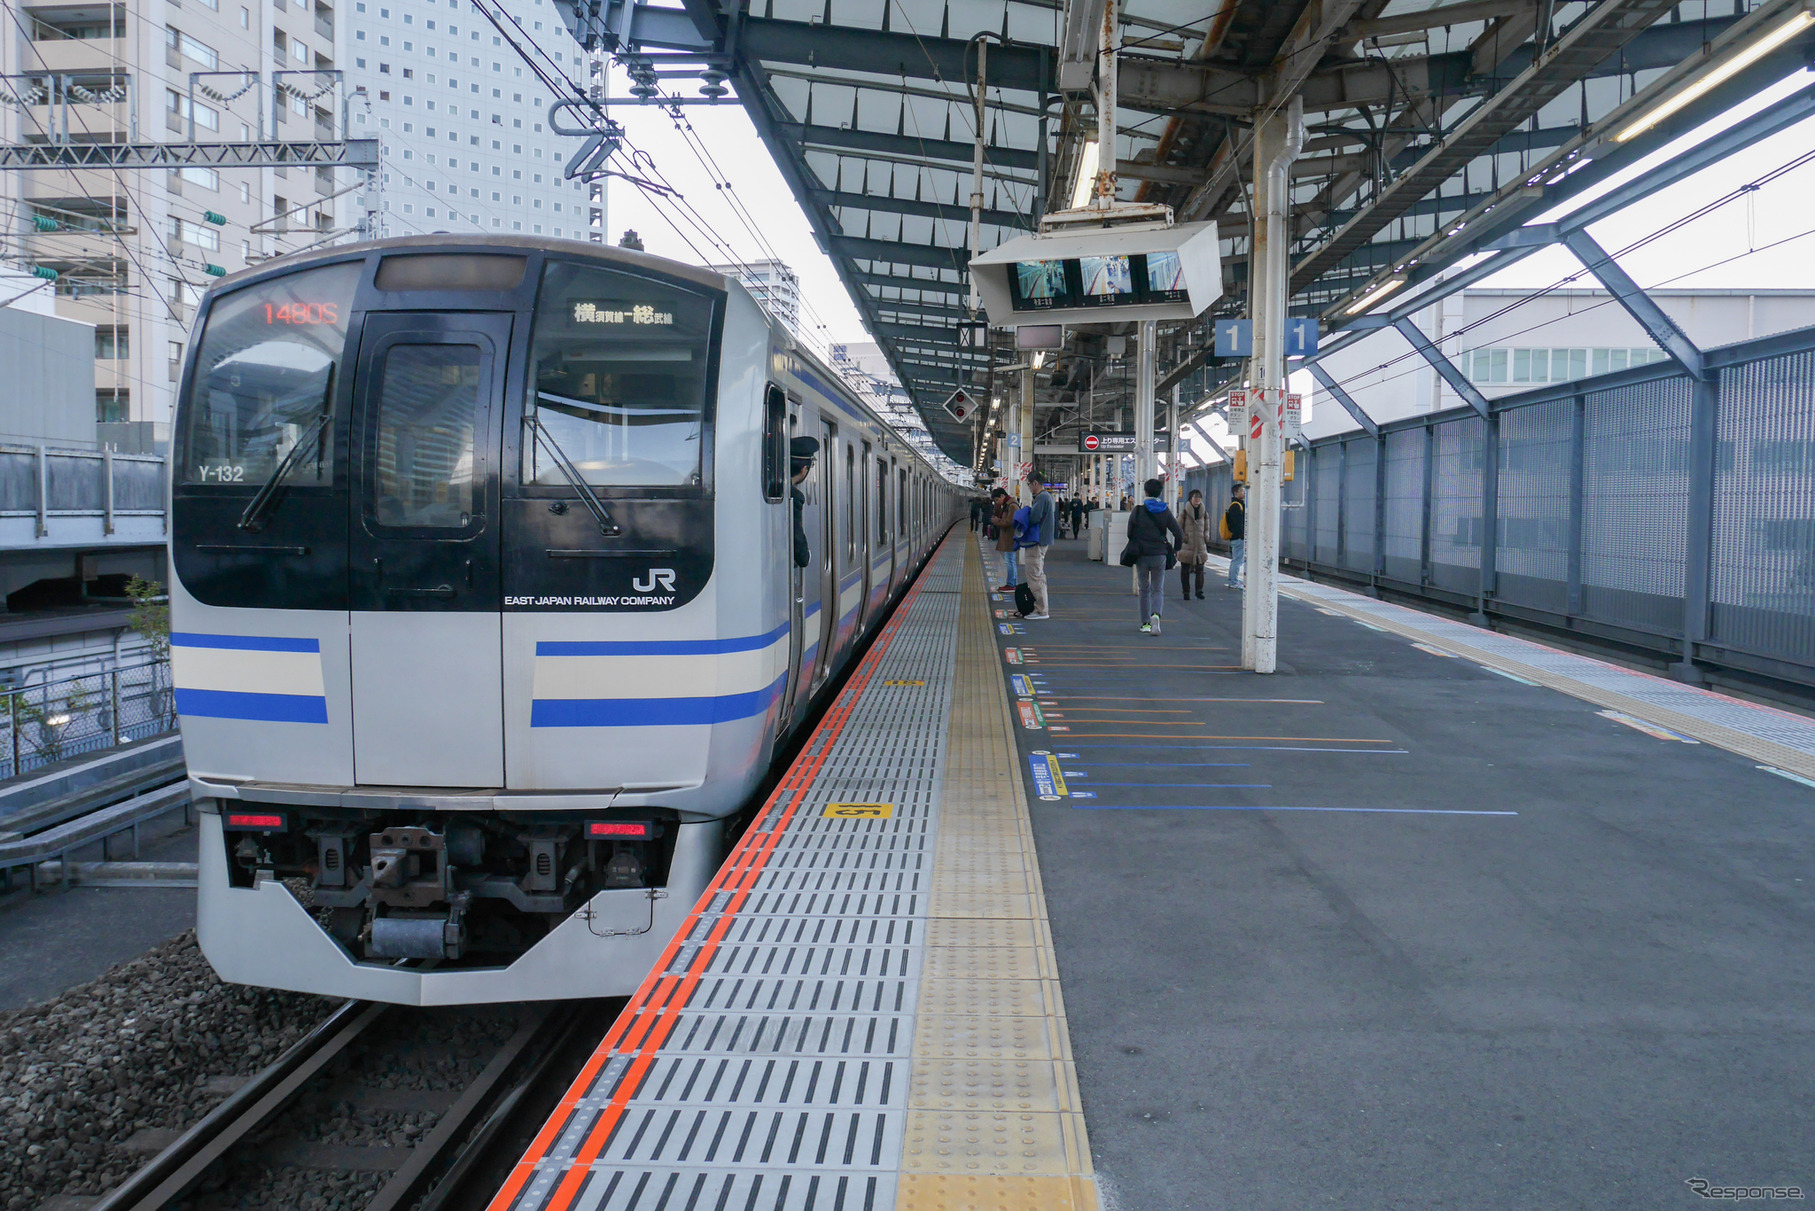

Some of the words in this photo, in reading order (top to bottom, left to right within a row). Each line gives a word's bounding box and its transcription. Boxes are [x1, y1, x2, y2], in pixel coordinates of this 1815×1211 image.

[265, 303, 338, 325] 1480S
[1226, 325, 1238, 350] 1
[1293, 324, 1304, 349] 1
[1010, 435, 1019, 446] 2
[1181, 440, 1189, 451] 2
[199, 465, 244, 482] Y-132
[632, 568, 676, 592] JR
[504, 596, 534, 605] EAST
[535, 596, 572, 605] JAPAN
[574, 596, 619, 606] RAILWAY
[620, 596, 675, 606] COMPANY
